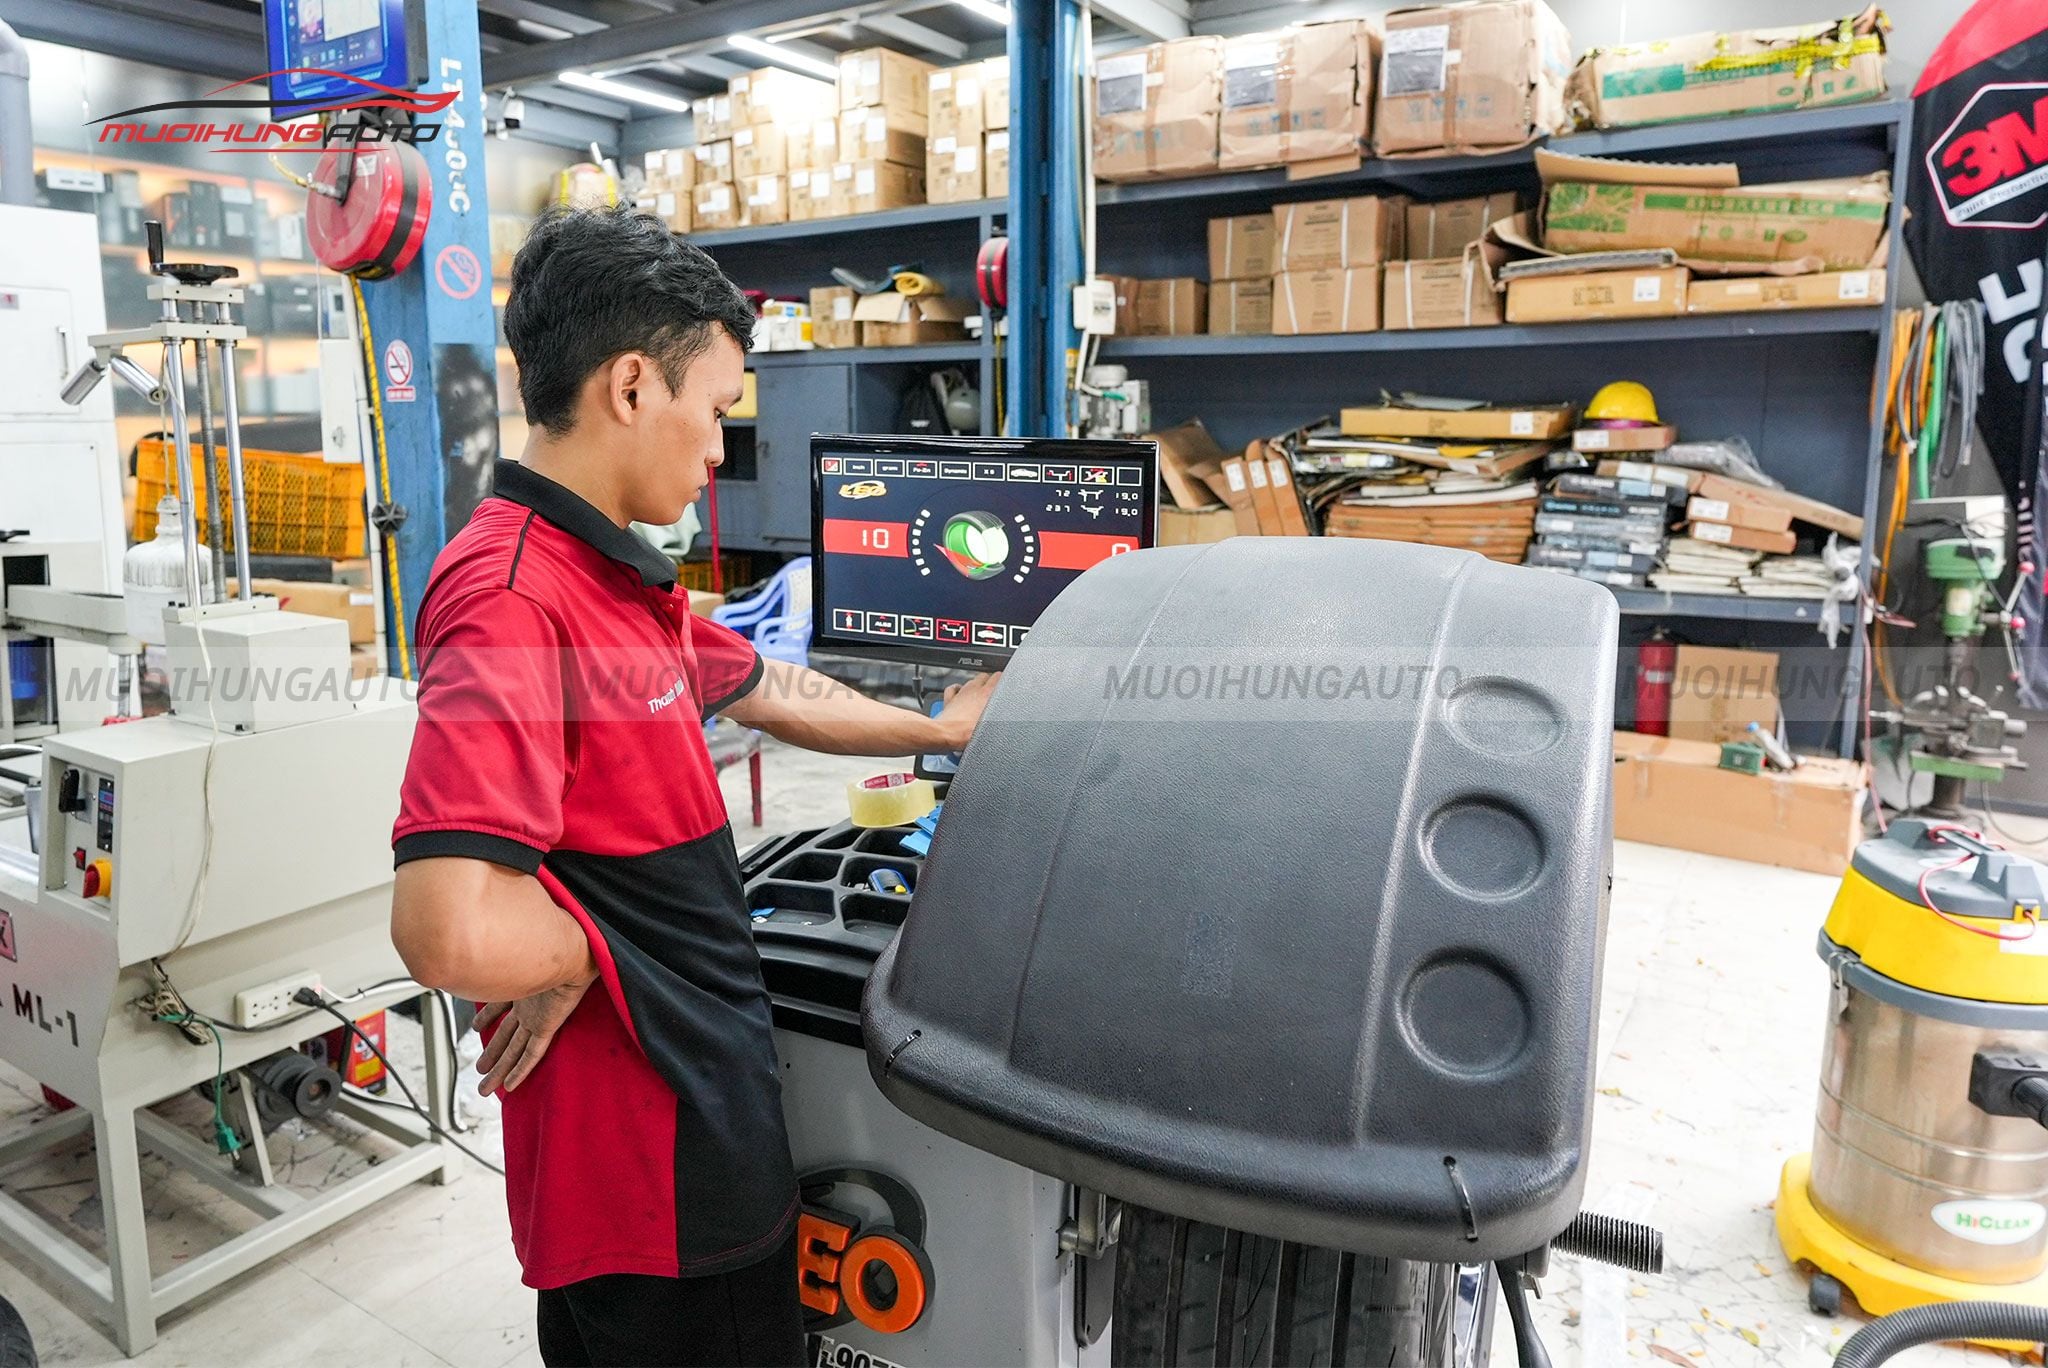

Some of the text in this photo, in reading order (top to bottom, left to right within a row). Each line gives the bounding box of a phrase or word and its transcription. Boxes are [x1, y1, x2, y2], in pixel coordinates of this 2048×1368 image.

[1942, 95, 2048, 197] 3M
[862, 528, 889, 549] 10
[958, 657, 983, 666] ASUS
[12, 983, 79, 1048] ML-1
[798, 1211, 926, 1334] EO
